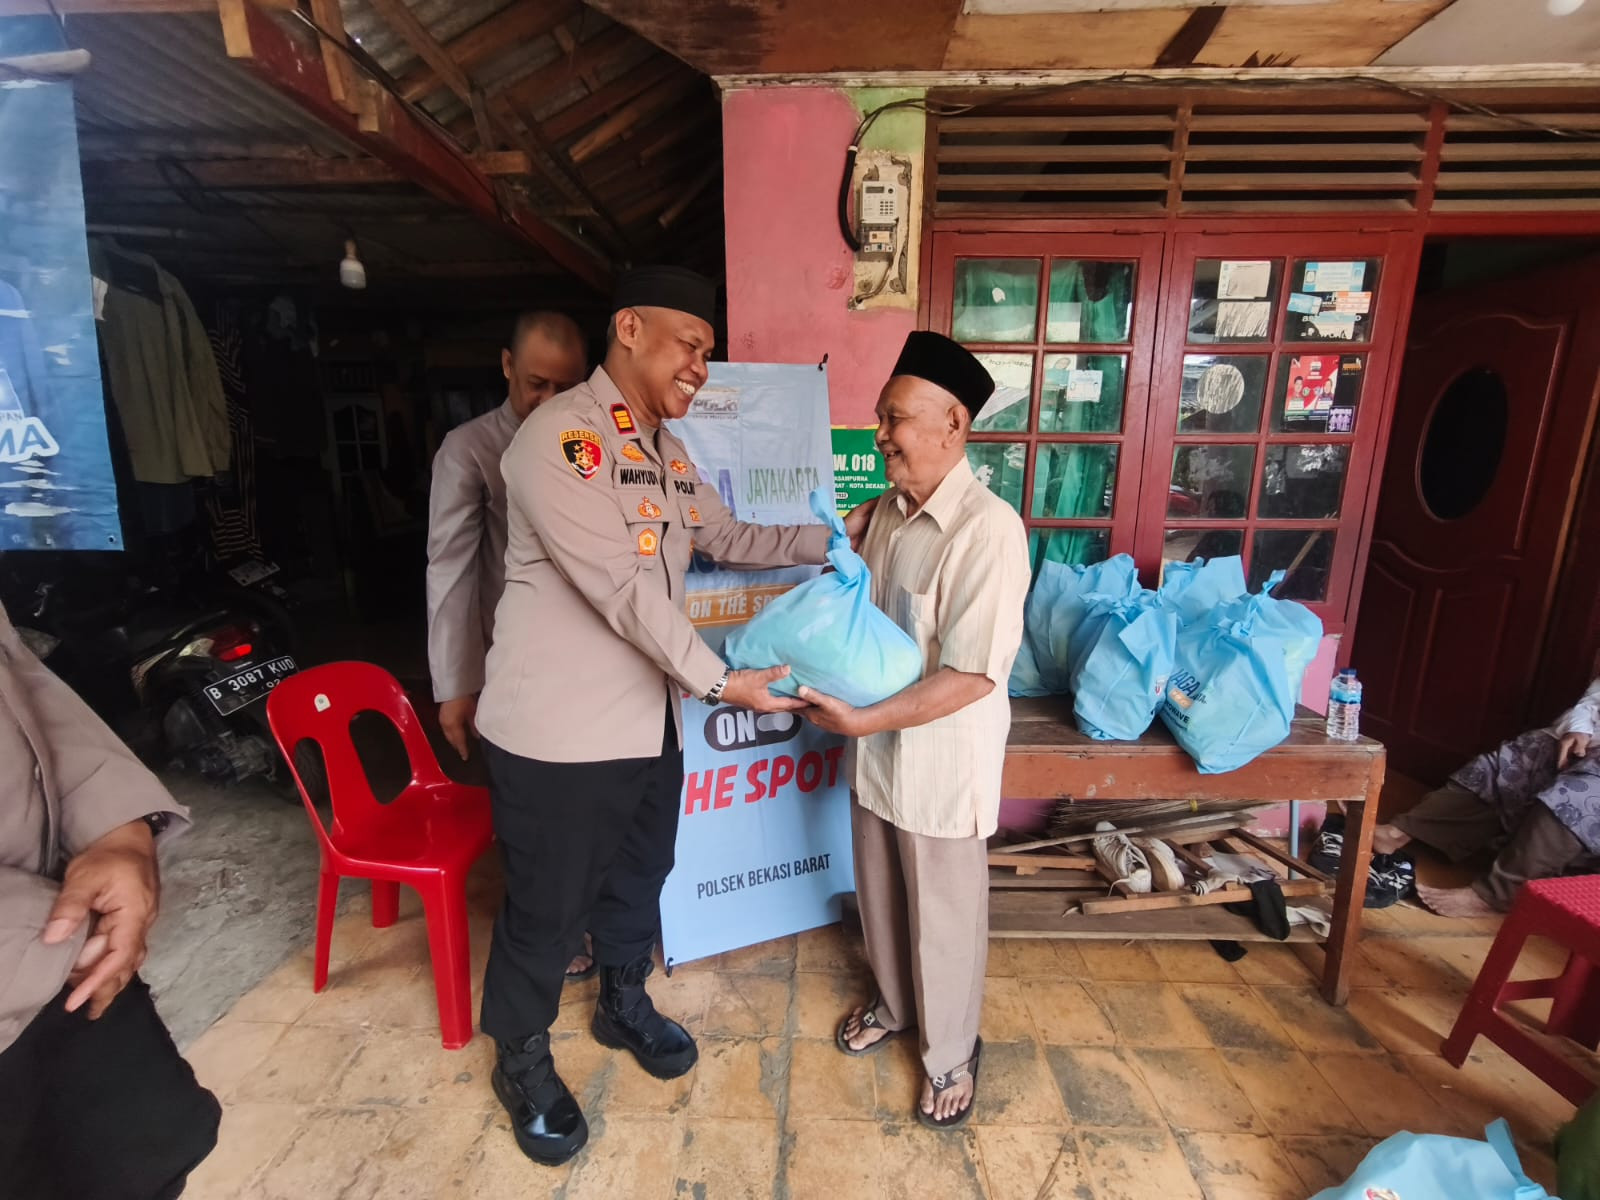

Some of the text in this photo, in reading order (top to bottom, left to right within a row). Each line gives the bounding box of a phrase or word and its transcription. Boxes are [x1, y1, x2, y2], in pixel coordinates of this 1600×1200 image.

[620, 468, 658, 485] WAHYUDI
[833, 454, 876, 471] W. 018
[747, 467, 820, 504] JAYAKARTA
[690, 594, 779, 619] ON THE SP
[209, 687, 222, 700] B
[228, 669, 264, 691] 3087
[716, 711, 756, 746] ON
[683, 745, 845, 816] HE SPOT
[697, 853, 831, 899] POLSEK BEKASI BARAT
